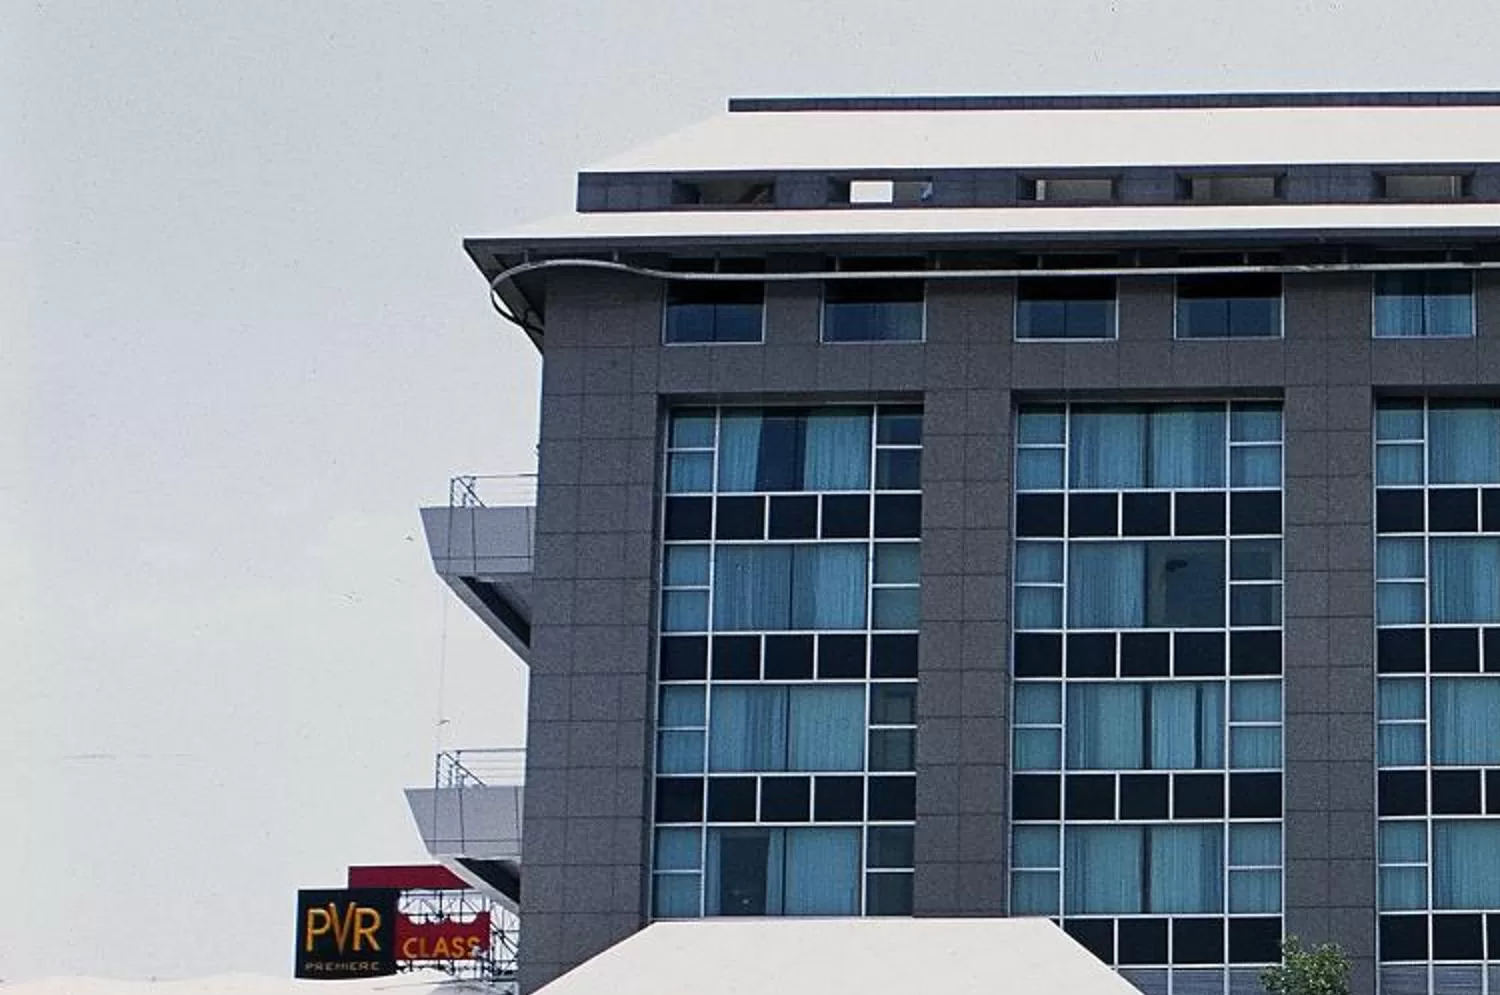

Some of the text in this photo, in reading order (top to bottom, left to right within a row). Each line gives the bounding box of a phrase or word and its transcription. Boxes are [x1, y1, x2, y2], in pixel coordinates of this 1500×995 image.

[306, 901, 381, 955] PVR
[403, 936, 480, 959] CLASS
[304, 961, 380, 972] PREMIERE
